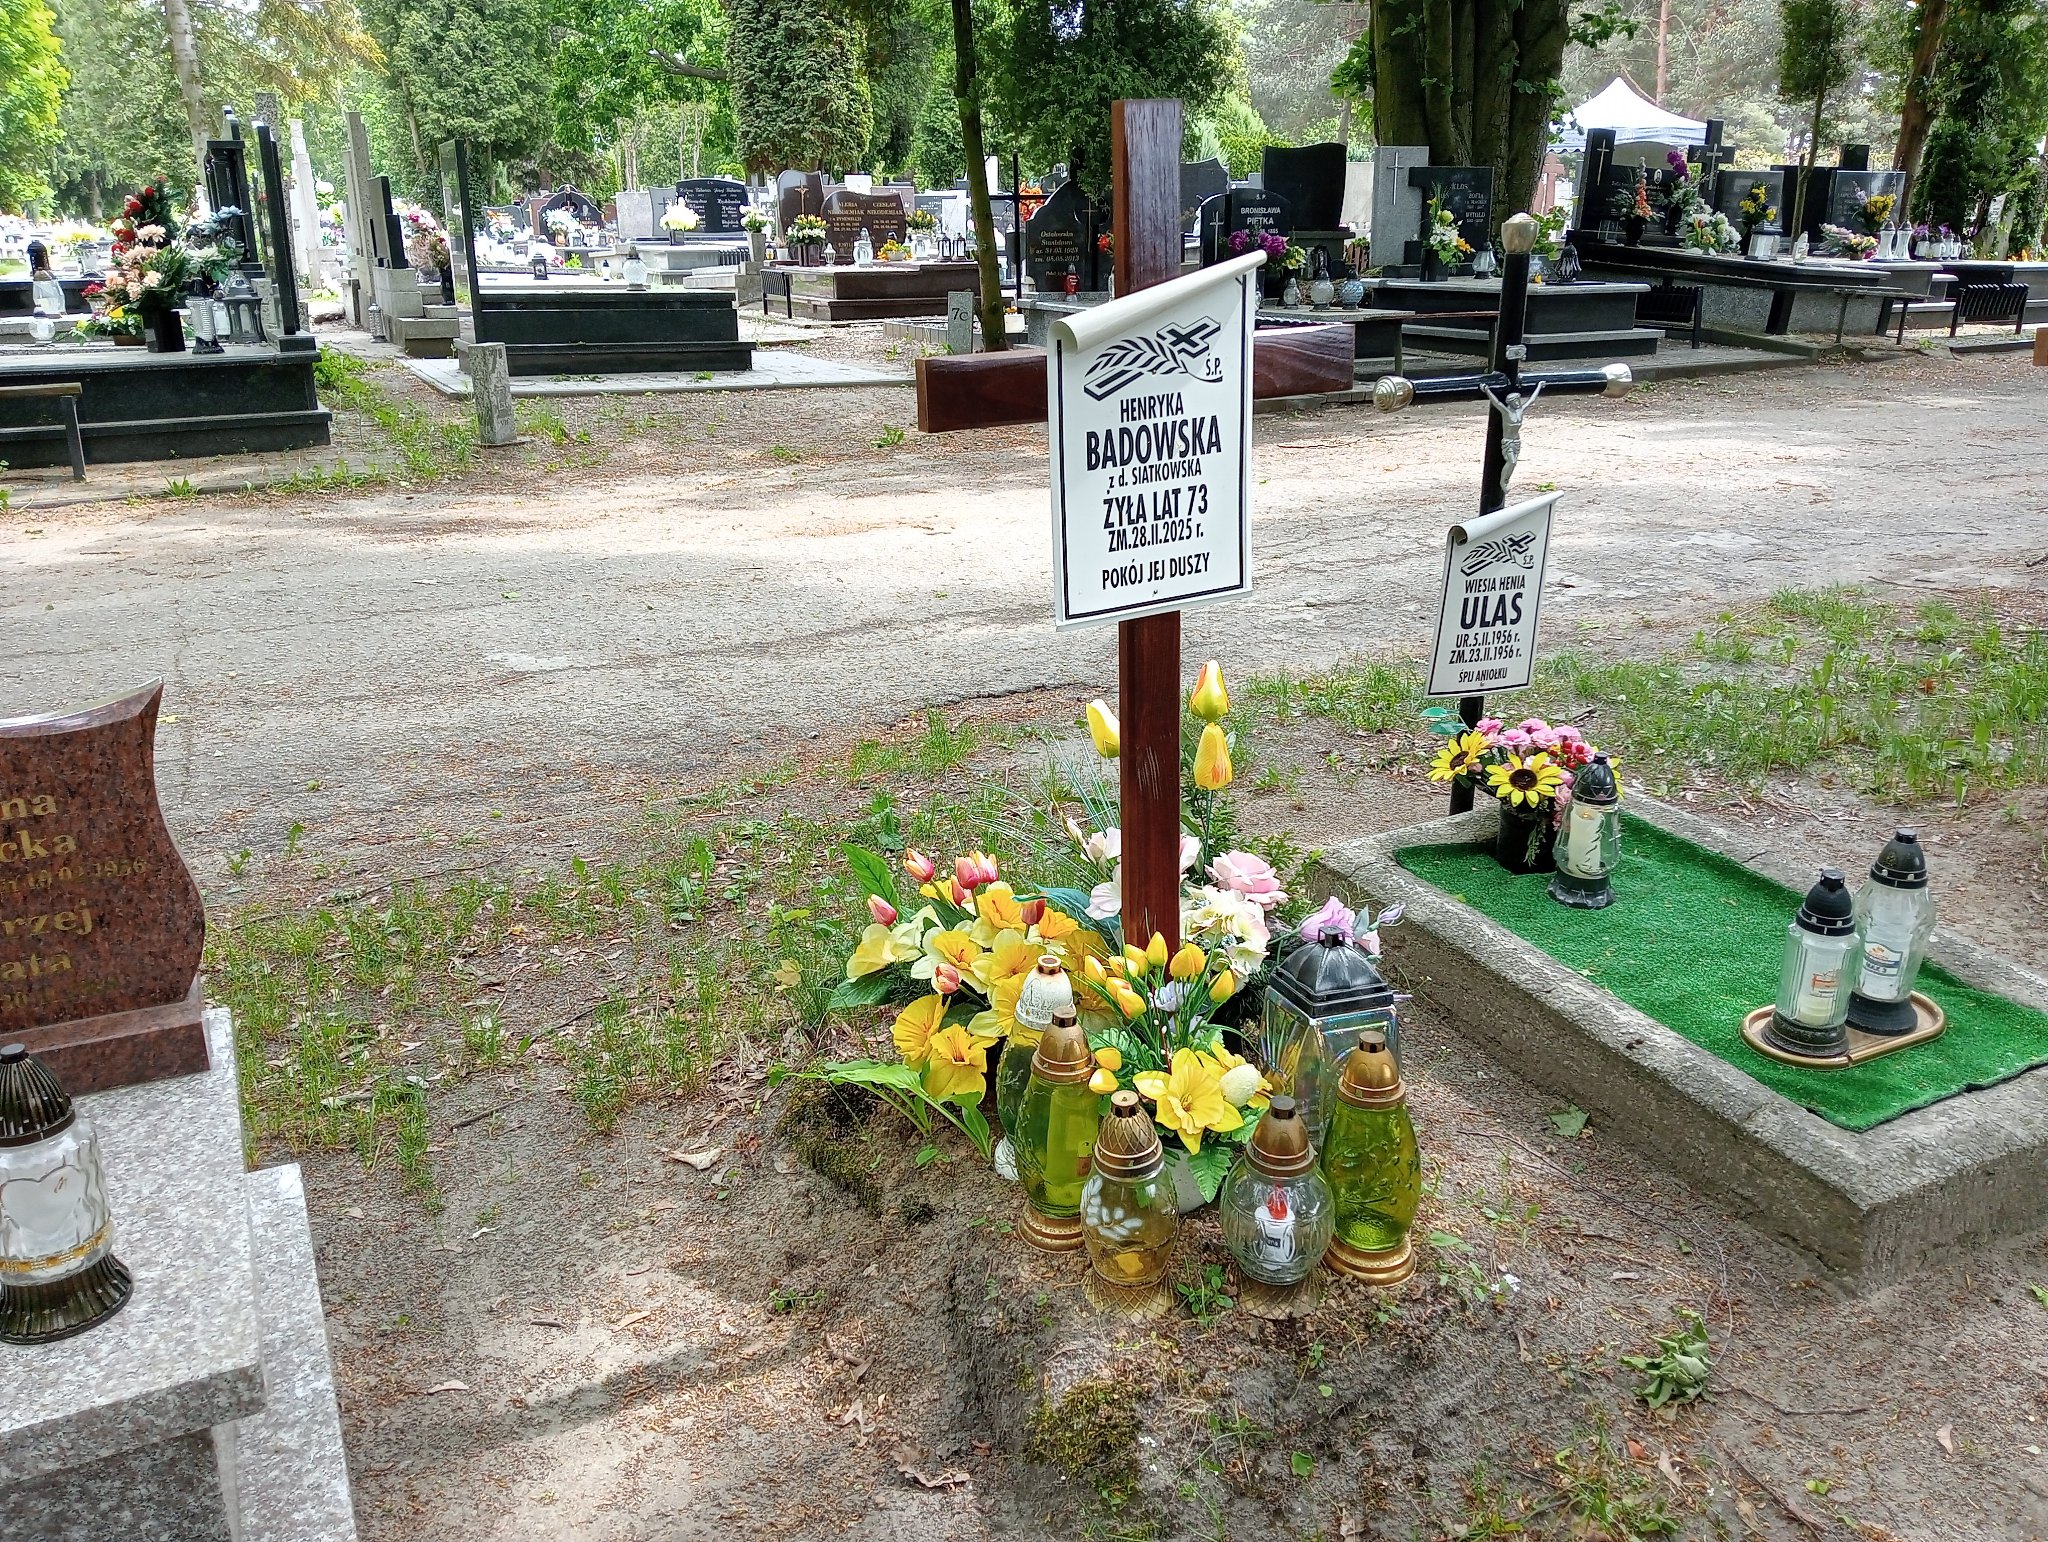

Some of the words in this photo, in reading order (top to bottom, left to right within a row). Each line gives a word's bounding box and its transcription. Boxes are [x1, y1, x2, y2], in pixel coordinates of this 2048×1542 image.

[1206, 353, 1222, 376] Ś.P.
[1120, 392, 1184, 423] HENRYKA
[1086, 415, 1222, 471] BADOWSKA
[1108, 475, 1115, 489] z
[1118, 467, 1128, 487] d.
[1132, 458, 1202, 486] SIATKOWSKA
[1103, 491, 1148, 529] ŻYŁA
[1153, 488, 1182, 521] LAT
[1187, 483, 1208, 516] 73
[1108, 518, 1192, 552] ZM.28.II.2025
[1196, 522, 1204, 539] r.
[1102, 558, 1144, 590] POKÓJ
[1148, 559, 1166, 582] JEJ
[1170, 552, 1211, 579] DUSZY
[1465, 578, 1496, 594] WIESIA
[1499, 575, 1526, 592] HENIA
[1460, 592, 1524, 630] ULAS
[1456, 629, 1513, 648] UR.5.II.1956
[1514, 632, 1521, 643] r.
[1449, 645, 1513, 665] ZM.23.II.1956
[1515, 647, 1522, 658] r.
[1458, 669, 1475, 683] ŚPIJ
[1475, 667, 1508, 682] ANIOŁKU
